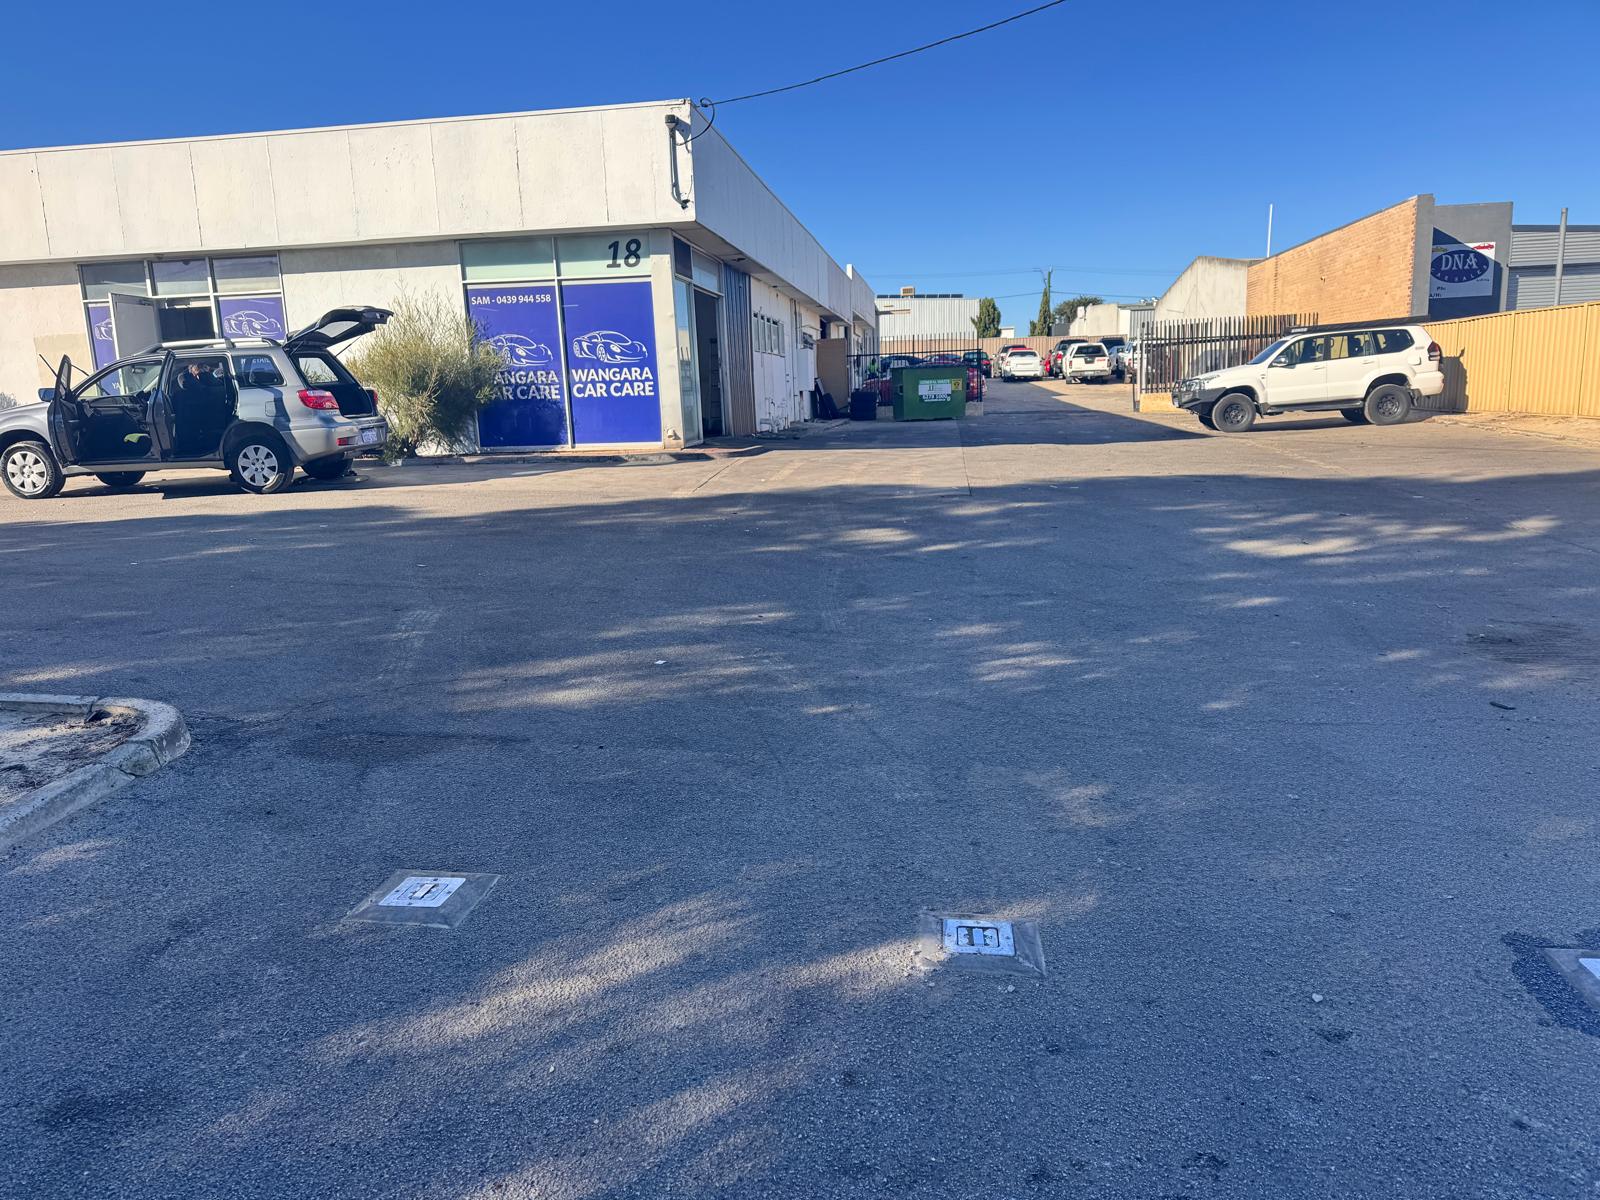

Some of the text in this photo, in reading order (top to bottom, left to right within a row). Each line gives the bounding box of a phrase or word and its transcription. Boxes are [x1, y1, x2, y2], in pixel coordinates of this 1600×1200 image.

[606, 238, 642, 268] 18
[1441, 253, 1478, 270] DNA
[471, 296, 491, 305] SAM
[496, 295, 517, 304] 0439
[518, 294, 534, 303] 944
[535, 294, 552, 303] 558
[493, 370, 559, 385] ANGARA
[572, 367, 653, 382] WANGARA
[492, 384, 561, 400] AR CARE
[572, 382, 655, 398] CAR CARE
